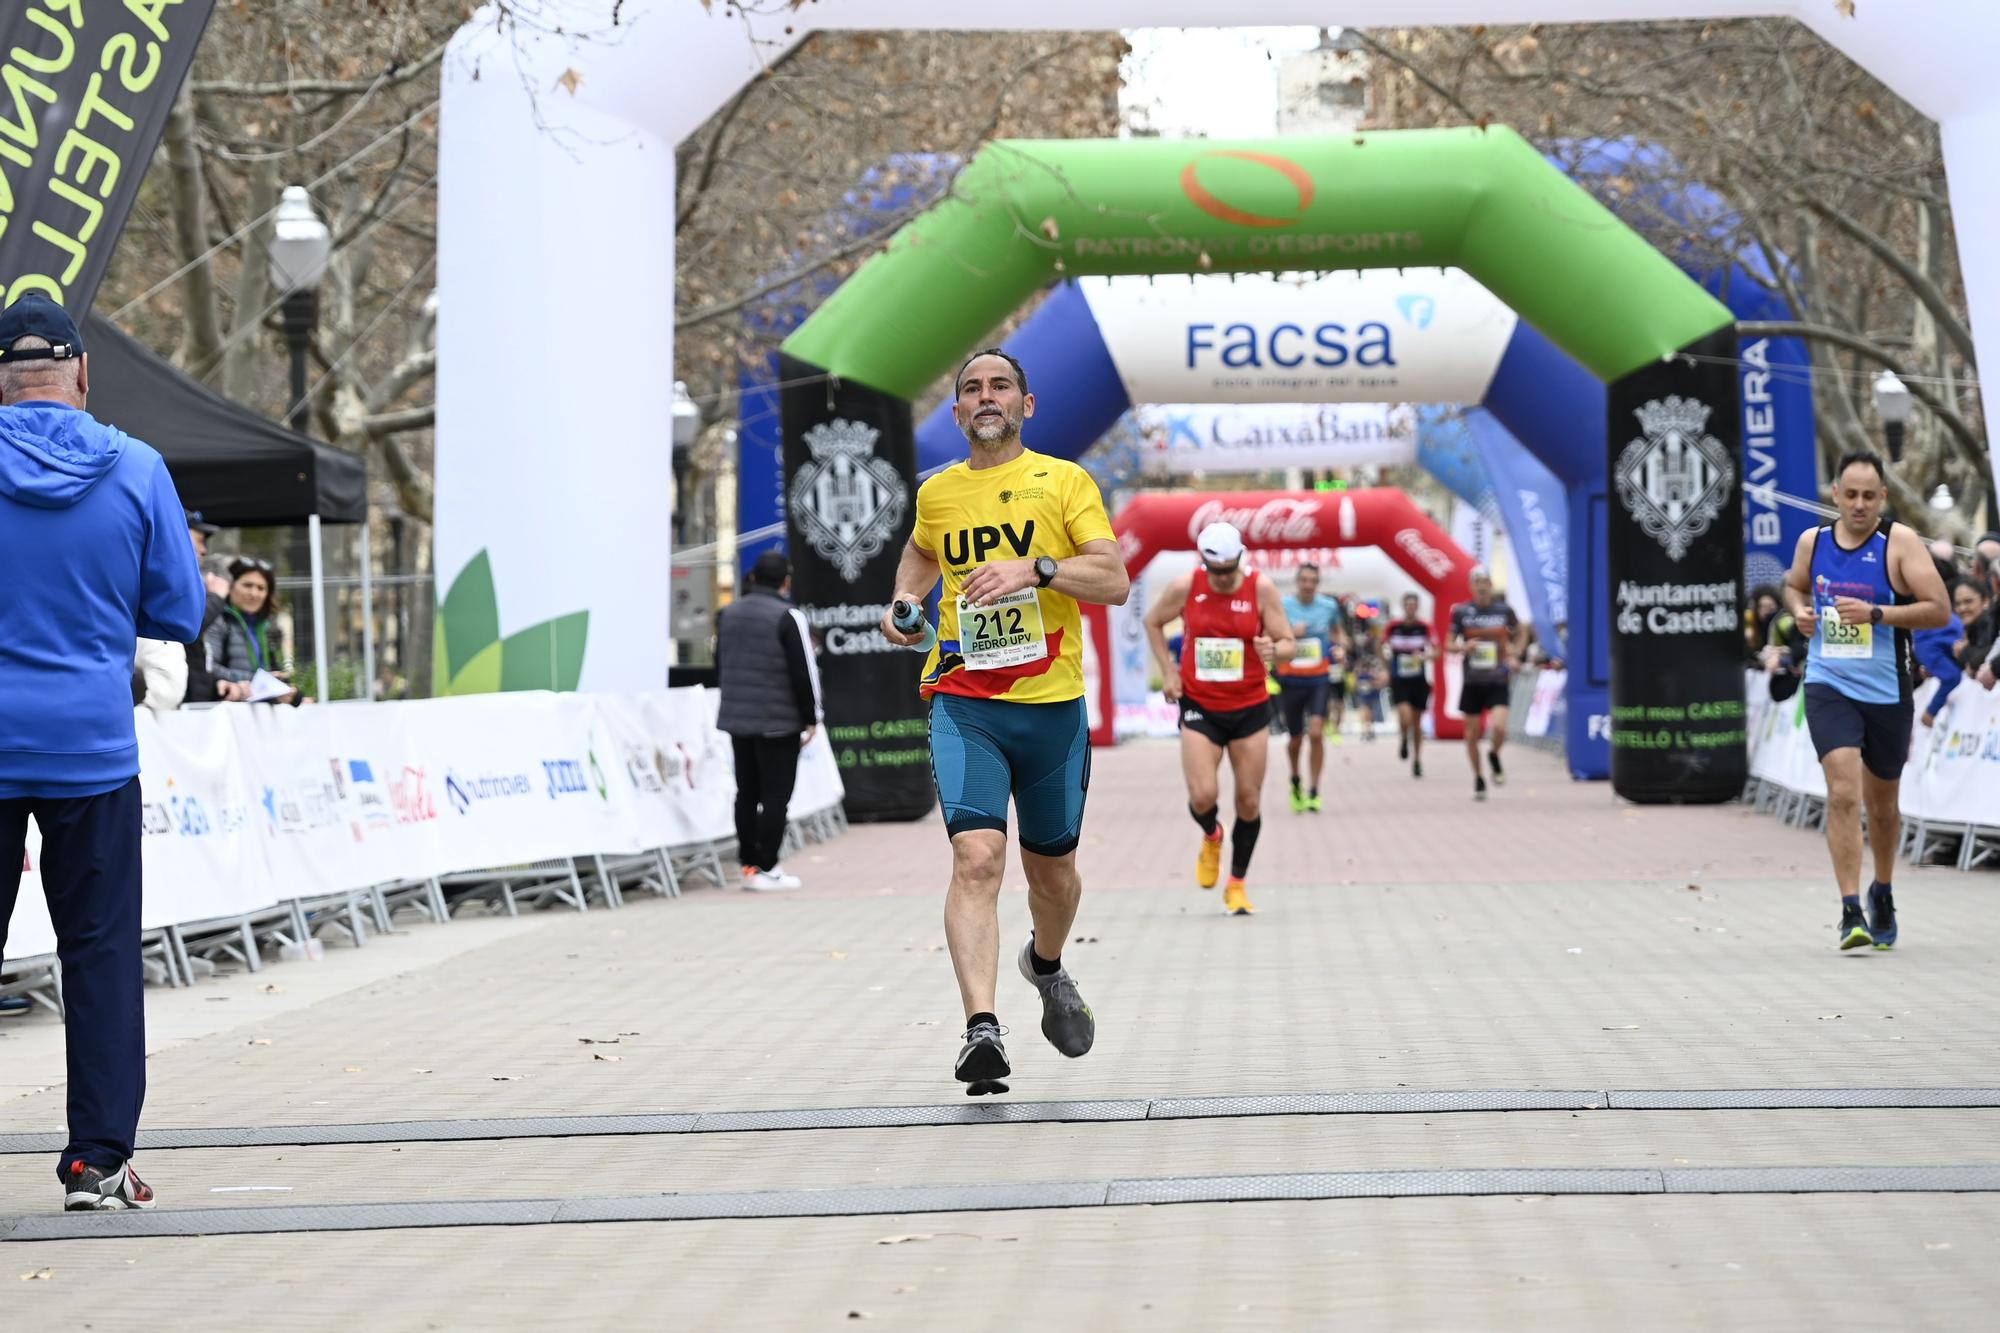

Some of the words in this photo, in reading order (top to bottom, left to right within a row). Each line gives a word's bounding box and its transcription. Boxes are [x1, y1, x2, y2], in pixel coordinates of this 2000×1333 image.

[1074, 236, 1239, 257] PATRONAT
[1249, 231, 1424, 254] D'ESPORTS
[1211, 405, 1405, 448] CaixaBank
[1742, 338, 1781, 545] BAVIERA
[943, 519, 1035, 566] UPV
[1616, 580, 1737, 607] Ajuntament
[973, 607, 1025, 640] 212
[1617, 604, 1643, 634] de
[1646, 603, 1738, 634] Castelló
[1828, 621, 1860, 637] 355
[972, 637, 1008, 651] PEDRO
[1010, 632, 1032, 646] UPV
